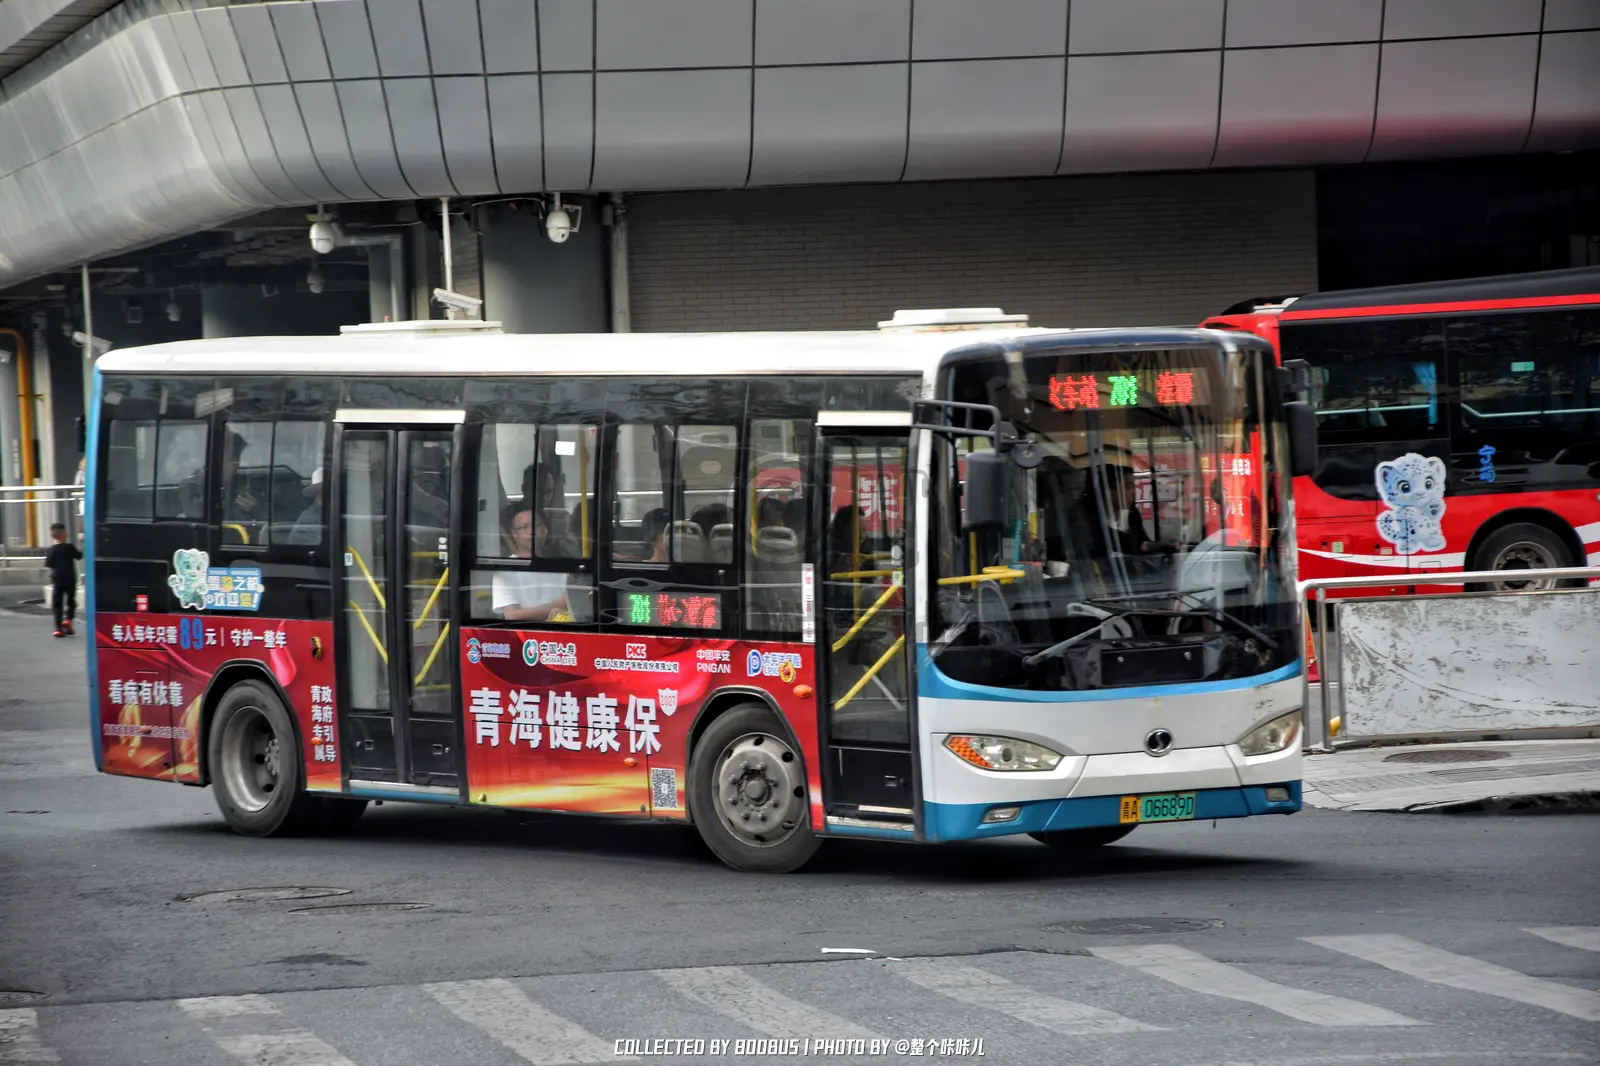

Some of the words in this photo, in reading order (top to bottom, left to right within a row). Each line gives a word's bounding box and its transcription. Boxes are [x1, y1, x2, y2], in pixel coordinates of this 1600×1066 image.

[230, 629, 287, 649] 守护一整年
[540, 643, 576, 656] 中国人寿
[628, 645, 646, 658] PICC
[697, 650, 731, 662] 中国平安
[541, 656, 561, 666] CHINA
[562, 657, 577, 666] LIFE
[697, 663, 732, 674] PINGAN
[469, 687, 661, 756] 青海健康保
